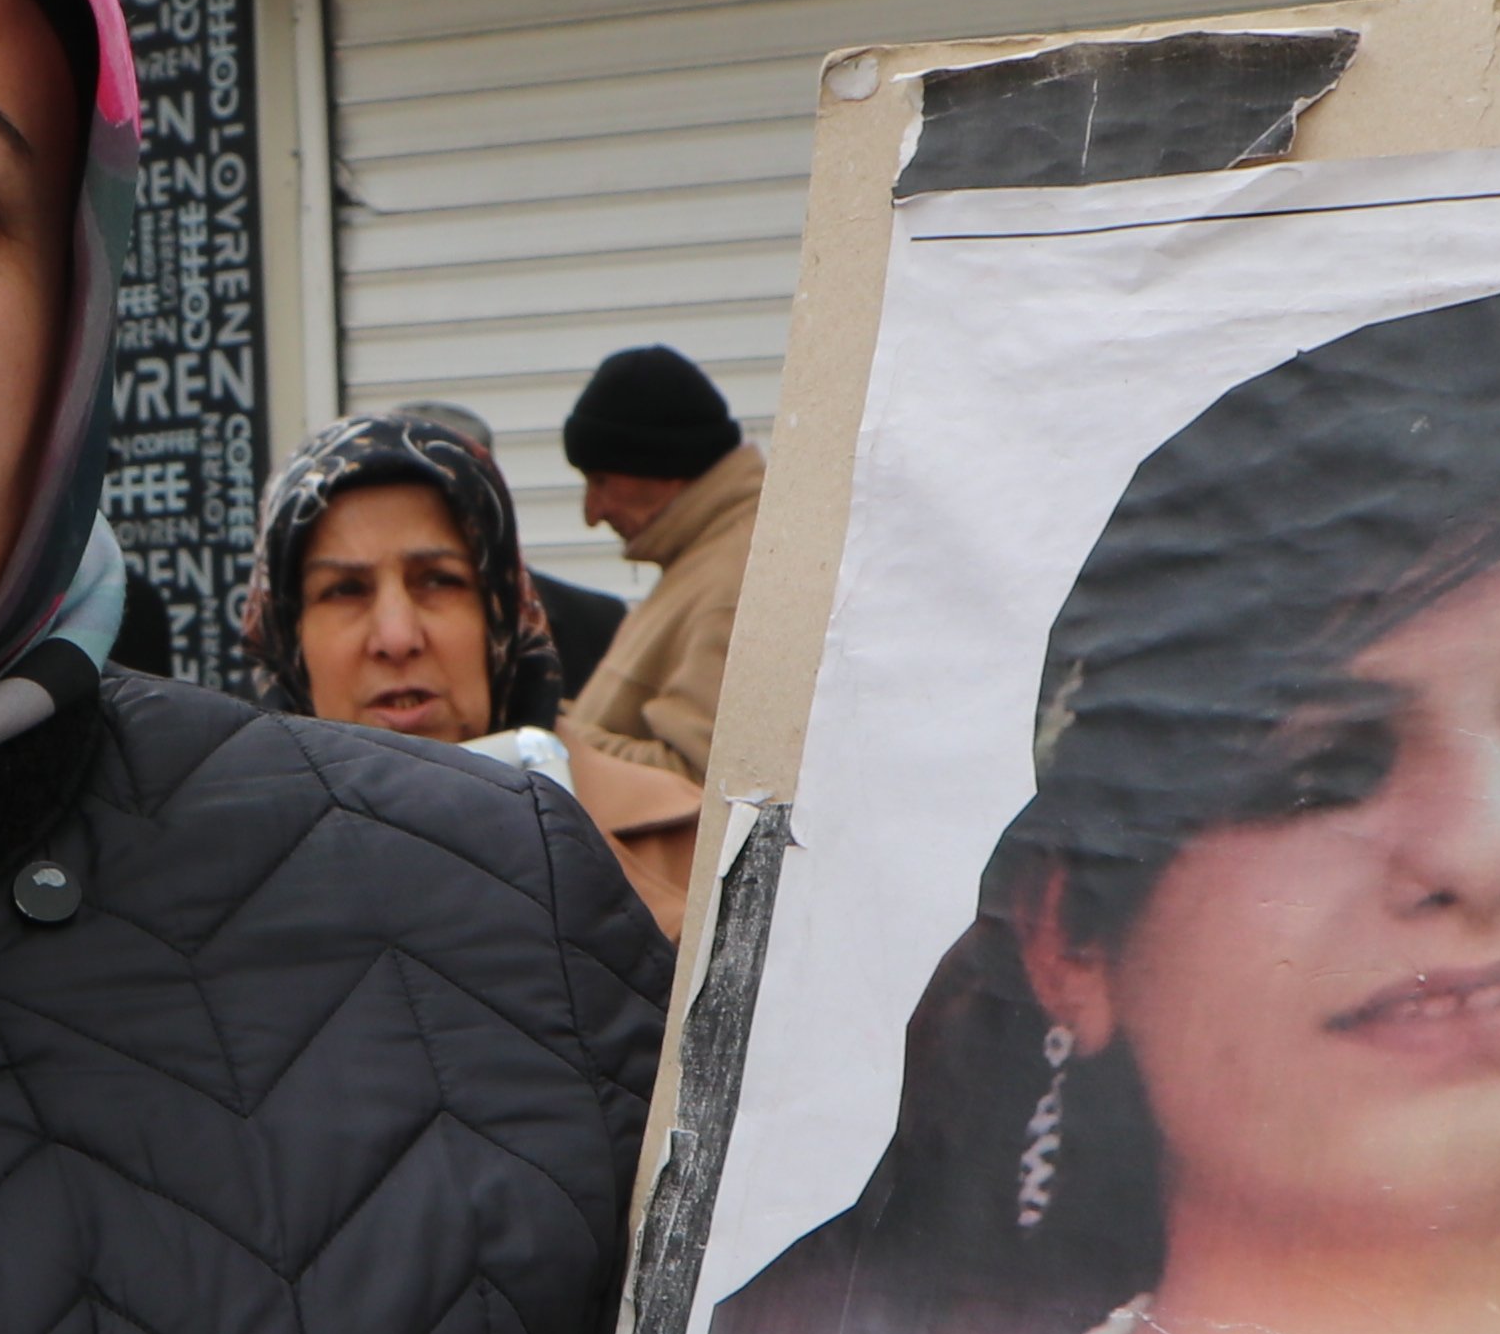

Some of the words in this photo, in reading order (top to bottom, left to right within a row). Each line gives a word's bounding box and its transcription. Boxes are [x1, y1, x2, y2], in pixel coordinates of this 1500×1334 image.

[178, 199, 212, 351] COFFEE
[208, 122, 253, 346] LOVREN
[224, 412, 257, 551] COFFEE
